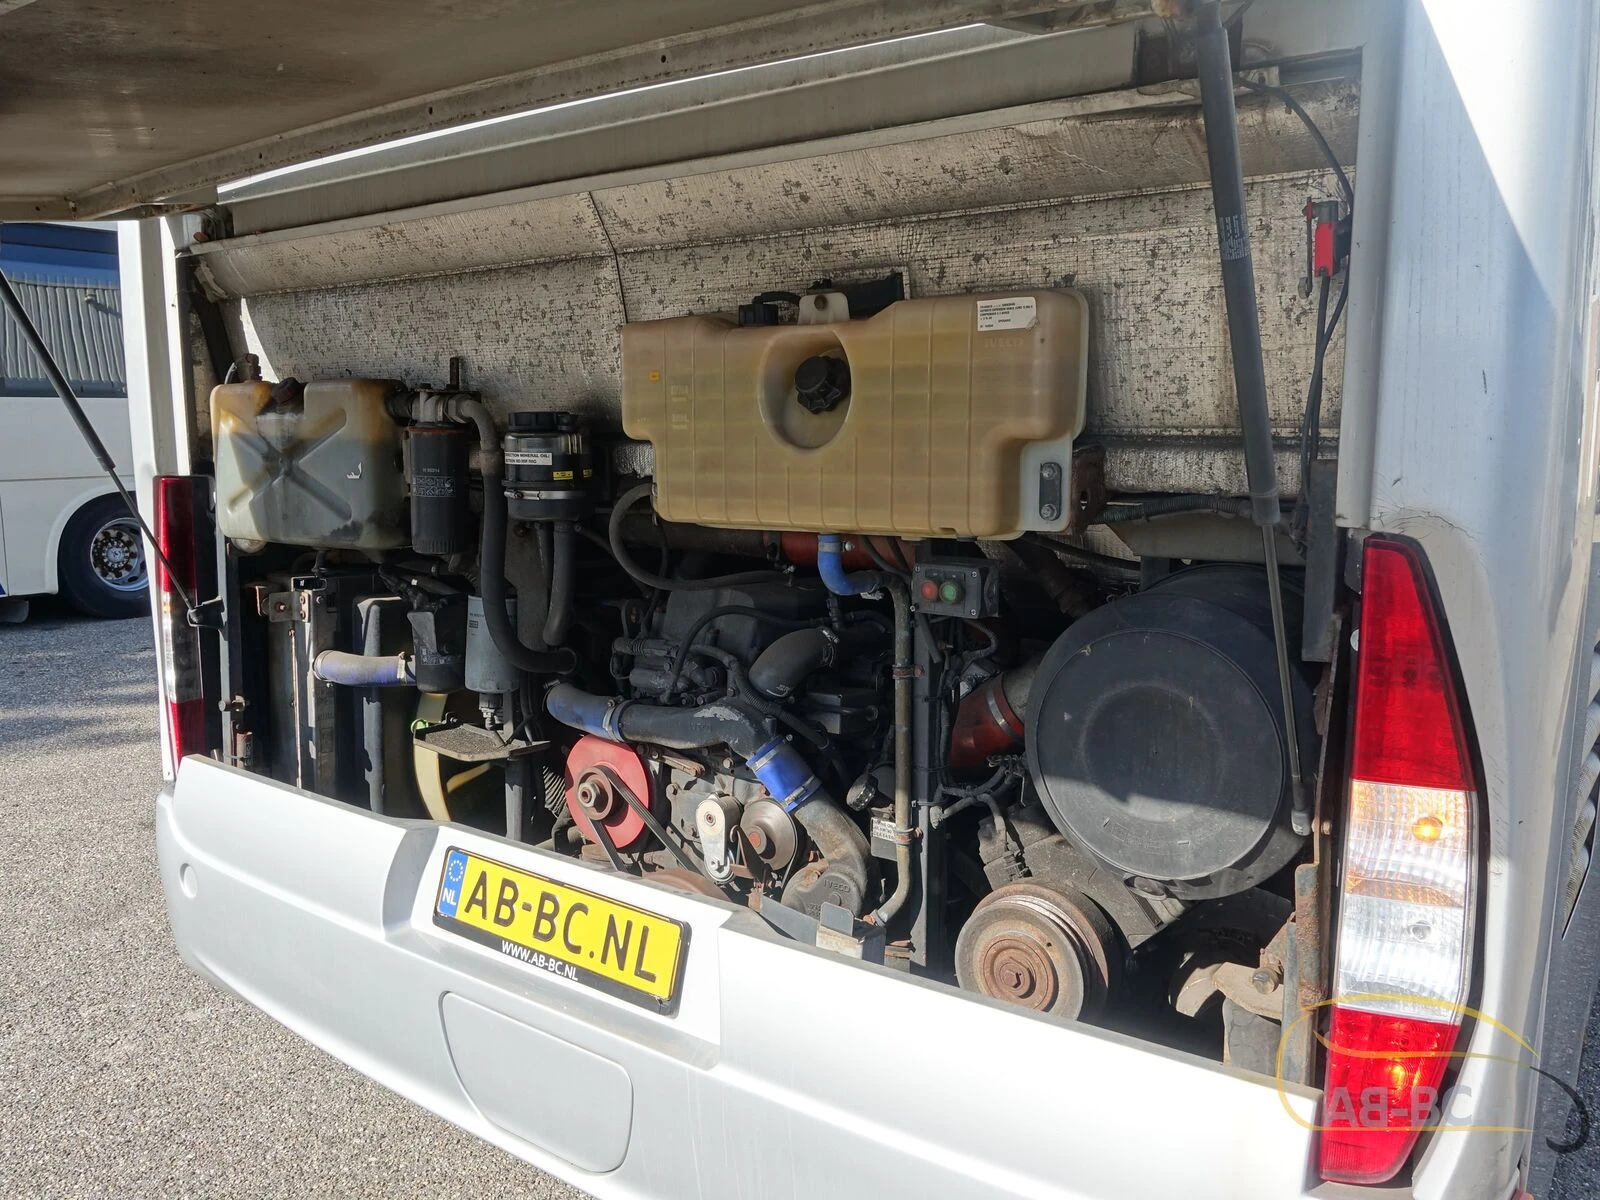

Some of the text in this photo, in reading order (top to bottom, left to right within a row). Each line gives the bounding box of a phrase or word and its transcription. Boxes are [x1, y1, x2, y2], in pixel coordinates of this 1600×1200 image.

[442, 888, 458, 906] NL
[824, 879, 850, 893] IVECO
[464, 870, 657, 983] AB-BC.NL
[501, 940, 579, 982] WWW.AB-BC.NL
